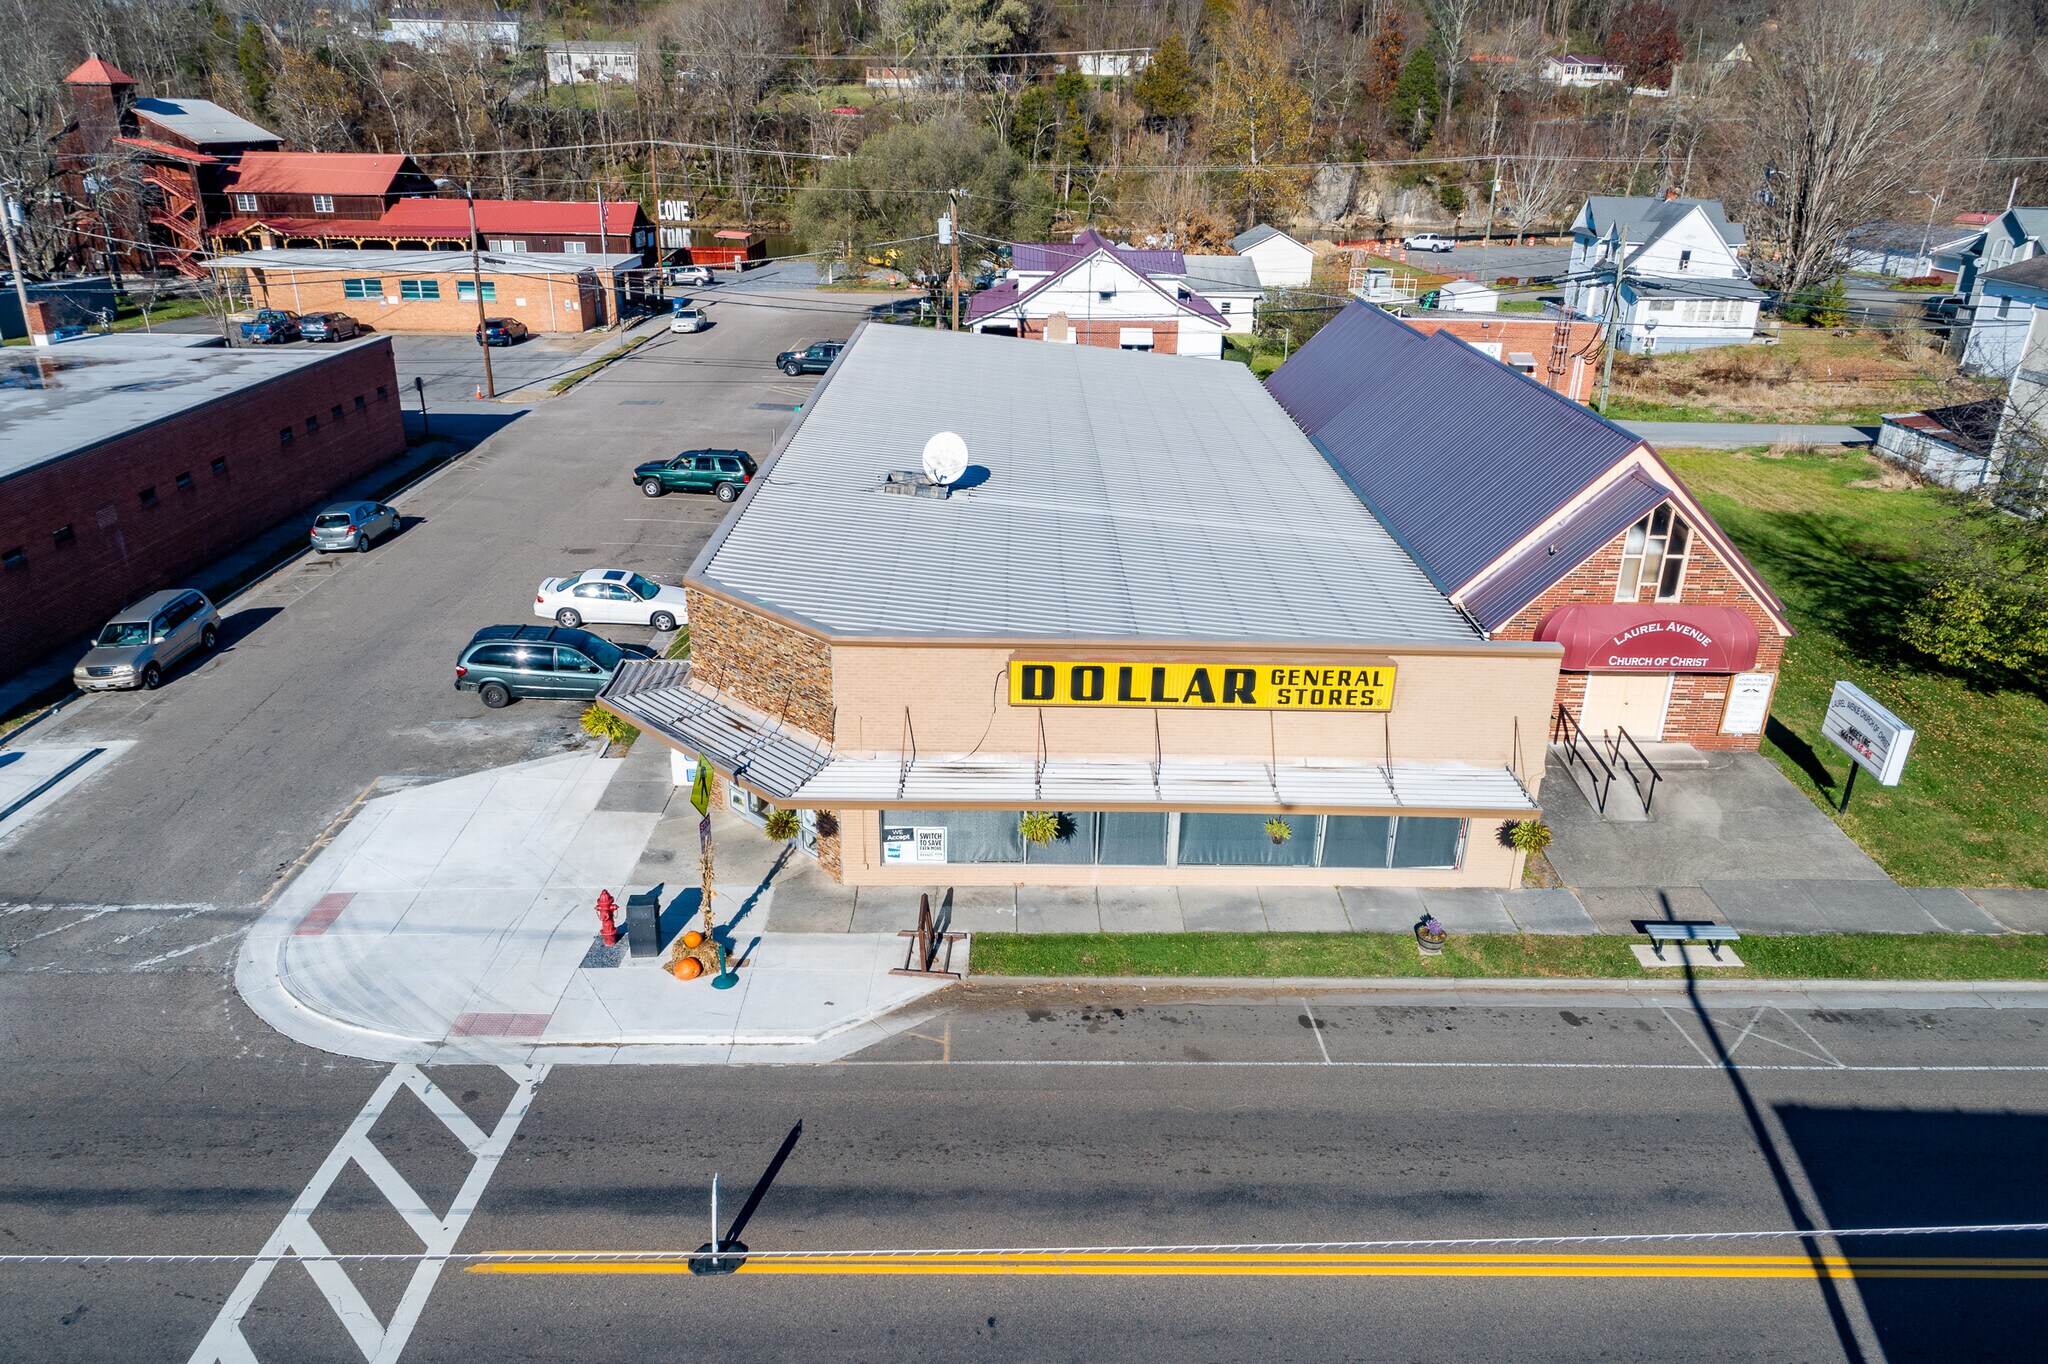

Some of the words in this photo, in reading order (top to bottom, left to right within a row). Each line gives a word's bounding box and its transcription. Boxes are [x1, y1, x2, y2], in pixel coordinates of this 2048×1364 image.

[657, 200, 690, 221] LOVE
[1613, 622, 1664, 646] LAUREL
[1665, 621, 1713, 647] AVENUE
[1608, 655, 1653, 667] CHURCH
[1654, 657, 1669, 666] OF
[1670, 656, 1709, 667] CHRIST
[1021, 664, 1258, 705] DOLLAR
[1271, 668, 1384, 688] GENERAL
